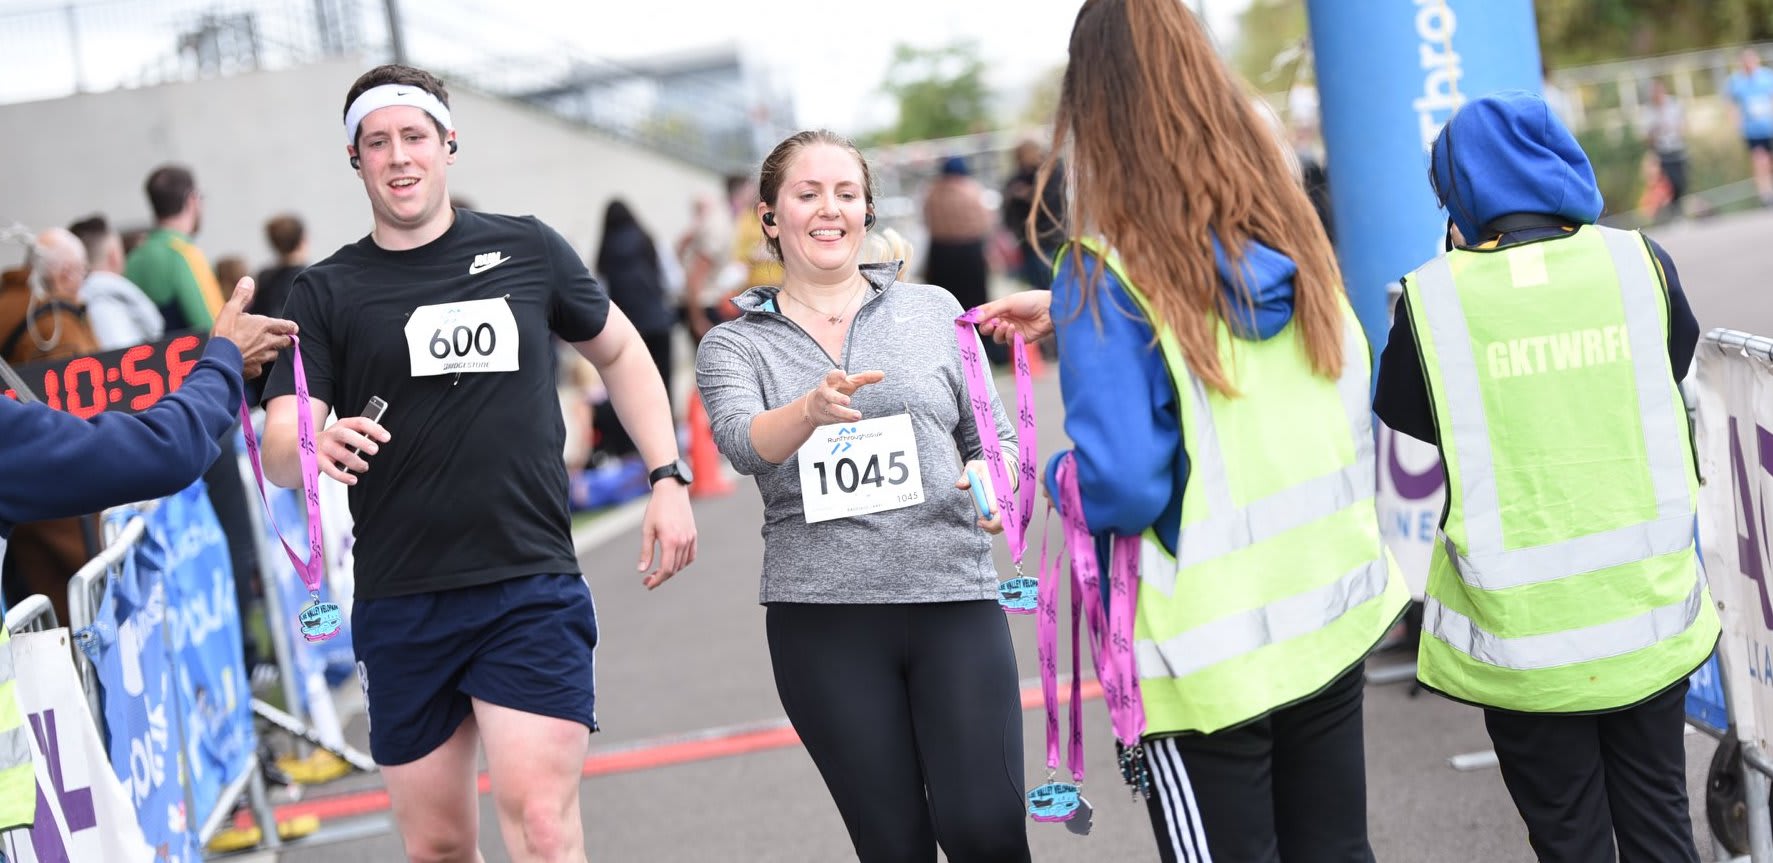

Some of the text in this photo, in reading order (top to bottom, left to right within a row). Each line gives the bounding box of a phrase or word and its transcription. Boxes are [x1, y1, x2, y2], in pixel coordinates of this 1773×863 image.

[429, 322, 496, 359] 600
[813, 450, 909, 496] 1045
[897, 491, 918, 503] 1045
